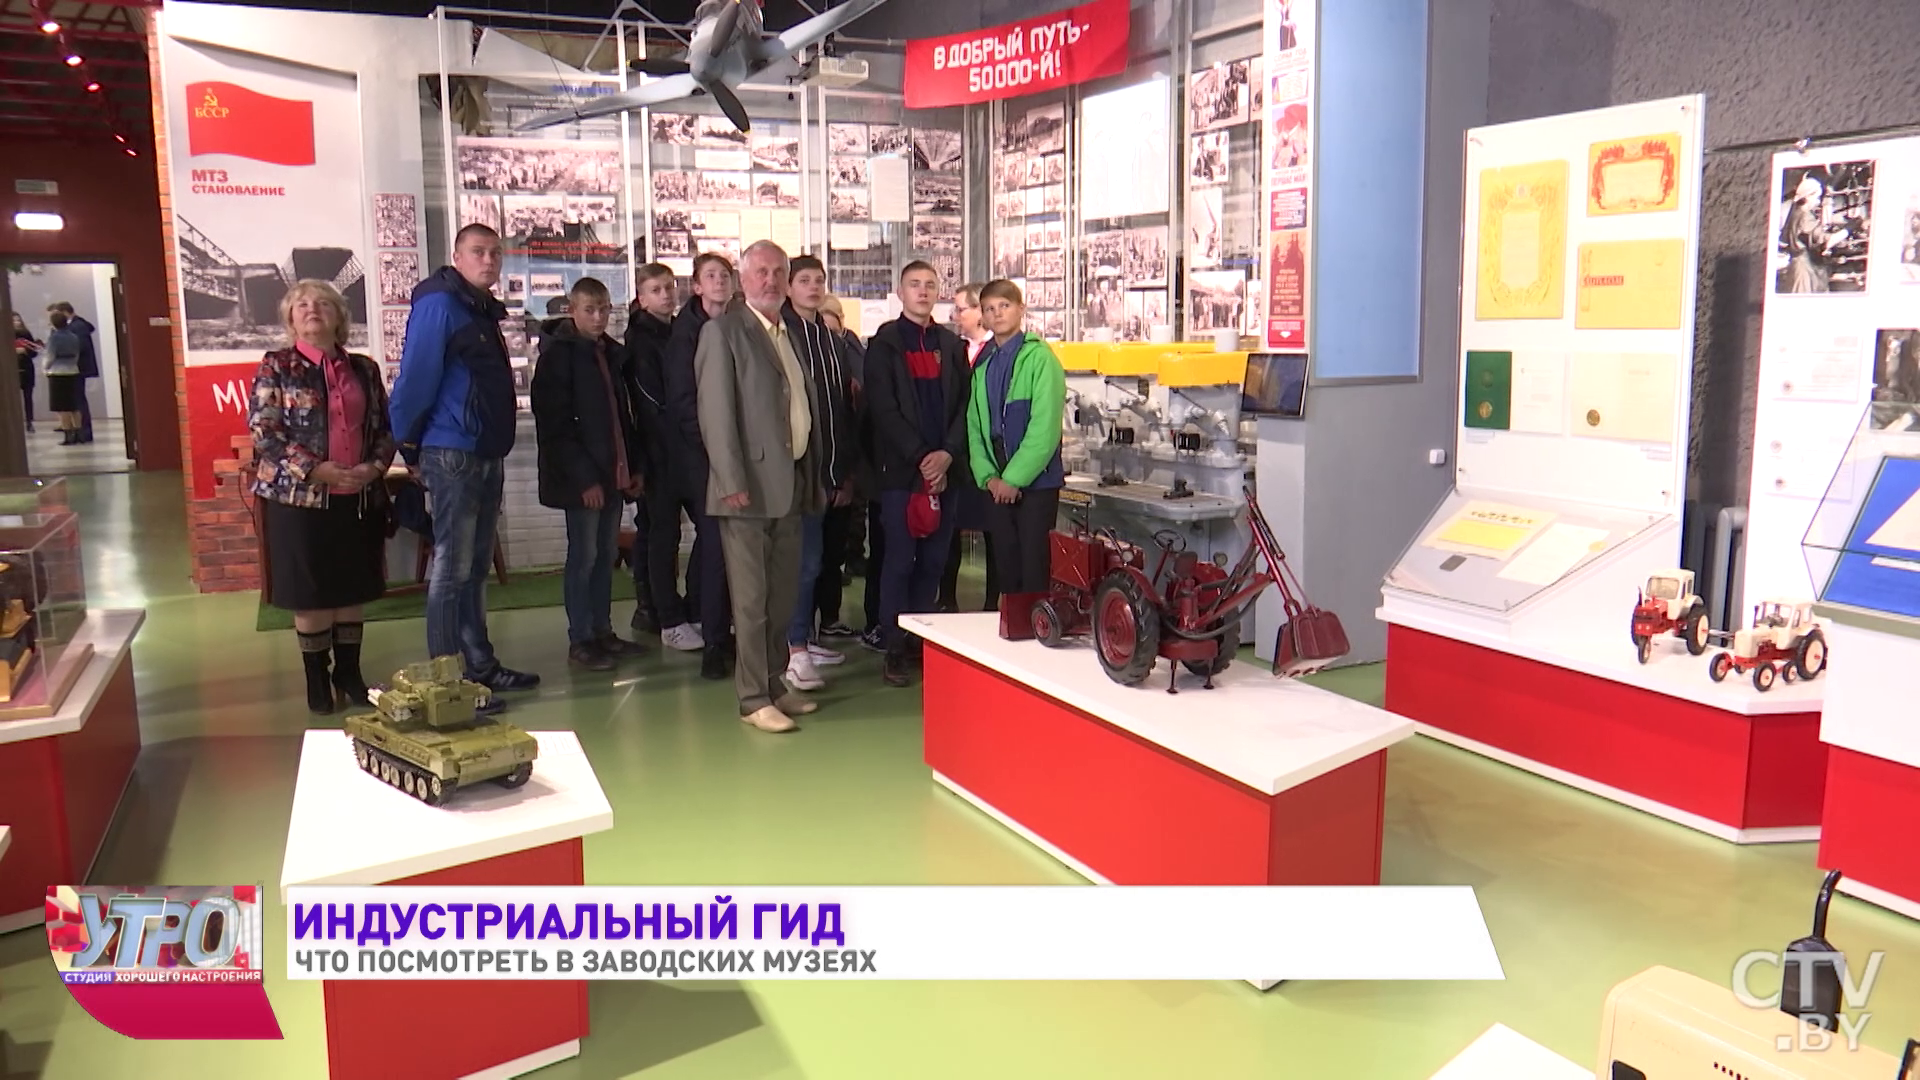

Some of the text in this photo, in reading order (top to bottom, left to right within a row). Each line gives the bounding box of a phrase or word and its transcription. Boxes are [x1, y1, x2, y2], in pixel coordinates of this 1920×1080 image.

[933, 45, 946, 70] В
[947, 26, 1024, 68] ДОБРЫЙ
[194, 107, 230, 118] БССР
[191, 169, 228, 182] МТЗ
[191, 185, 286, 196] СТАНОВЛЕНИЕ
